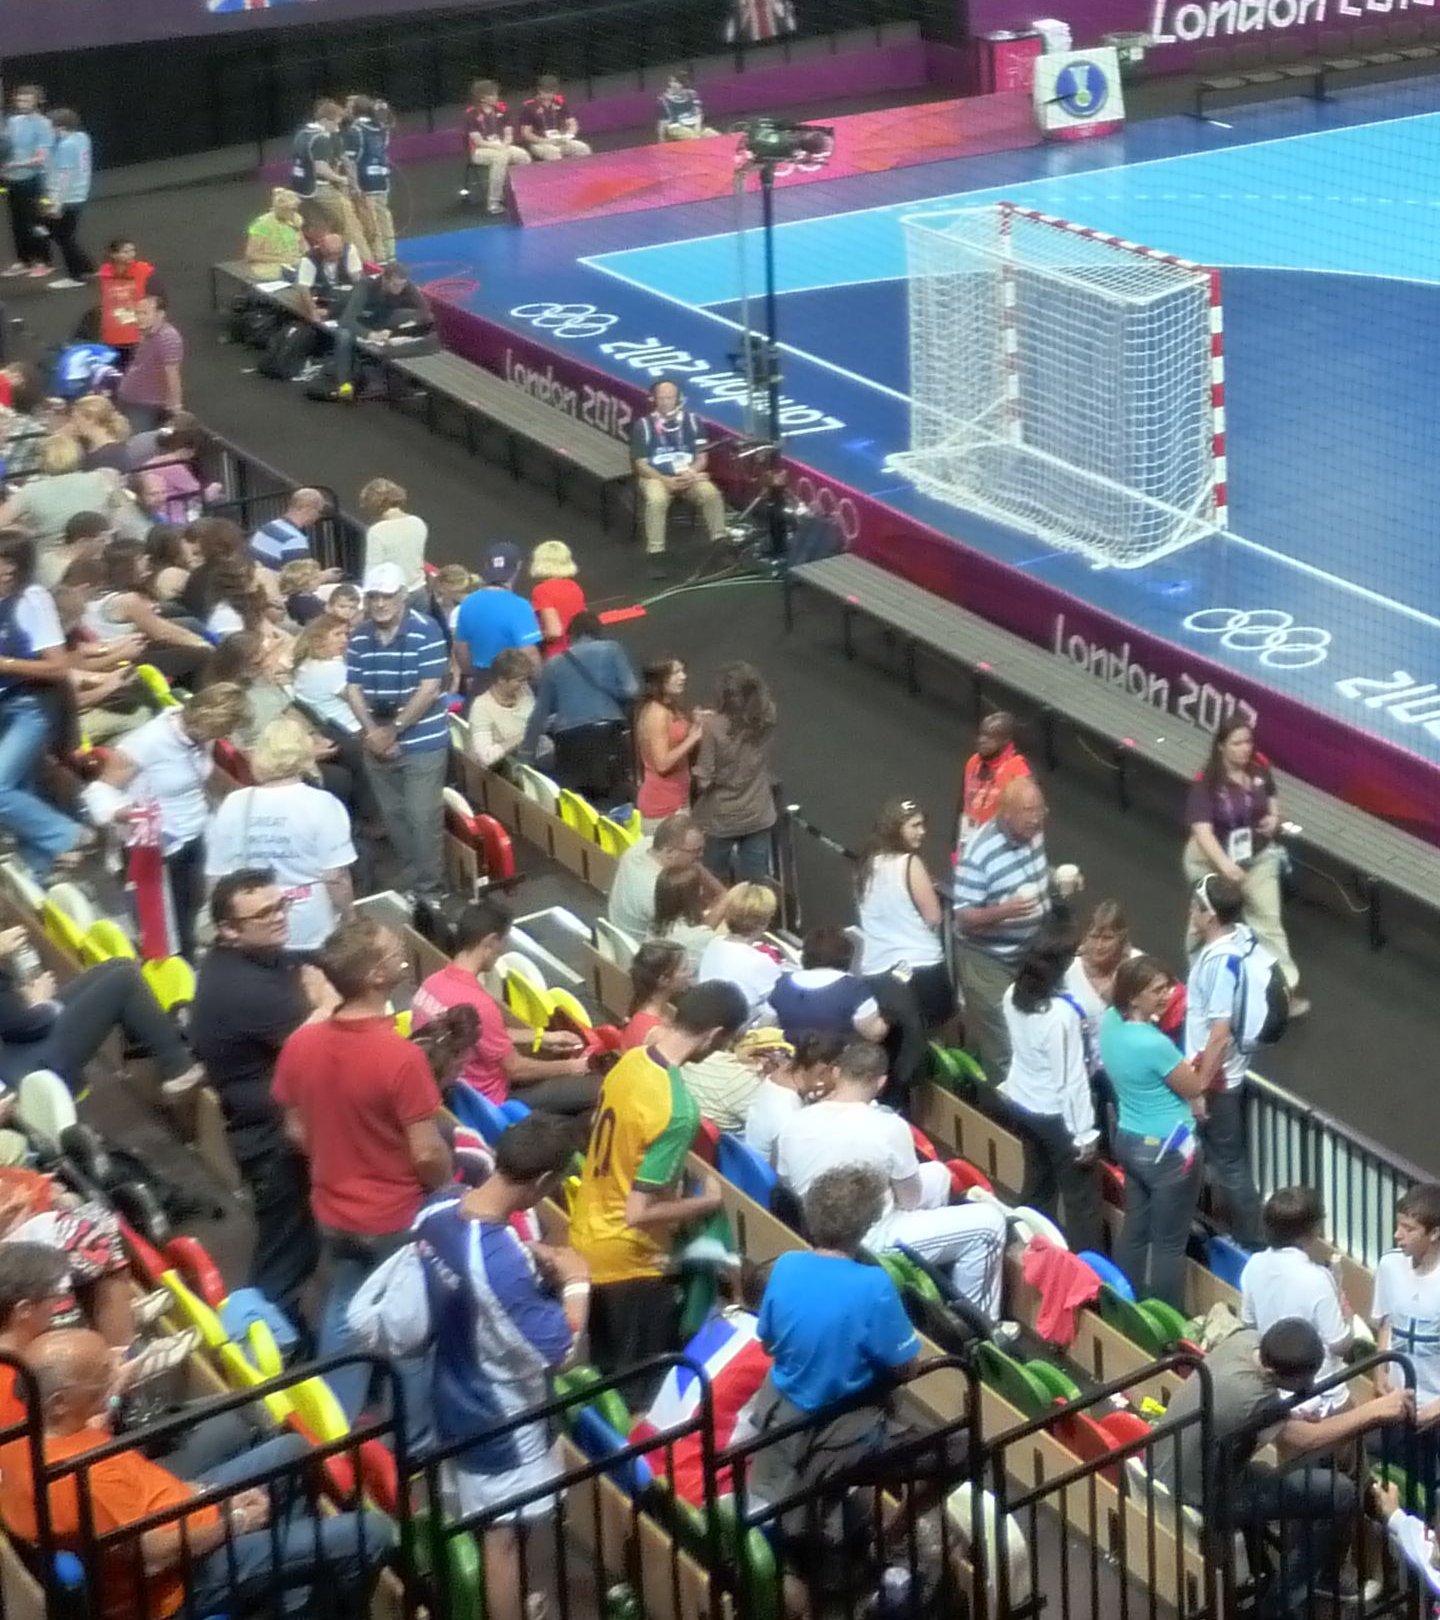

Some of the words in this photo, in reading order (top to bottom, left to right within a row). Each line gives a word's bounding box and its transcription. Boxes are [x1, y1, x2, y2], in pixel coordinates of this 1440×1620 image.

[505, 347, 577, 421] London
[581, 384, 634, 442] 2012
[599, 336, 711, 377] 2012
[1053, 613, 1170, 713] London
